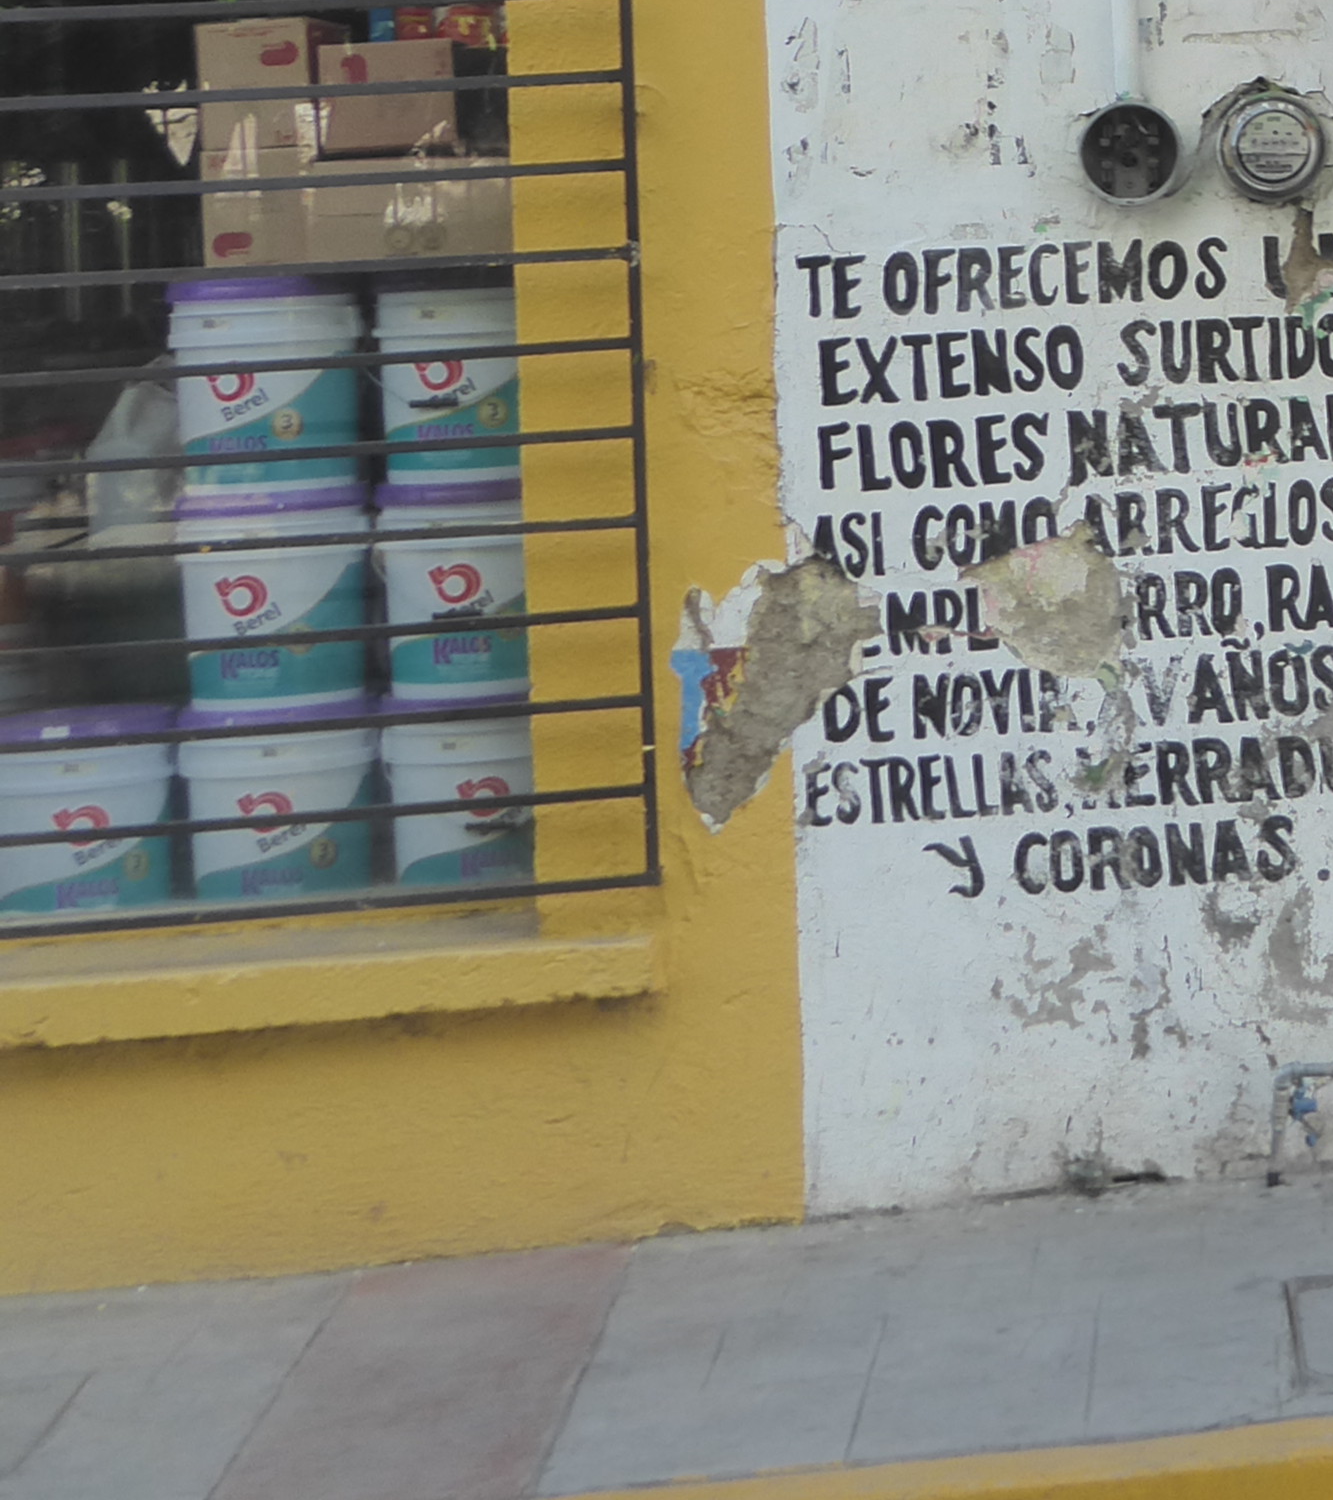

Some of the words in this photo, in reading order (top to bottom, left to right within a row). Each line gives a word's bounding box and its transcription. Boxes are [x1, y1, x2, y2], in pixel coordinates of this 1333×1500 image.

[796, 254, 866, 320] TE
[882, 236, 1228, 316] OFRECEMOS
[818, 324, 1085, 407] EXTENSO
[220, 386, 270, 423] Berel
[817, 412, 1050, 492] FLORES
[812, 511, 886, 579] ASI
[911, 496, 1059, 571] COMO
[233, 601, 282, 637] Berel
[433, 635, 492, 666] KALOS
[220, 649, 280, 679] KALOS
[822, 675, 896, 743] DE
